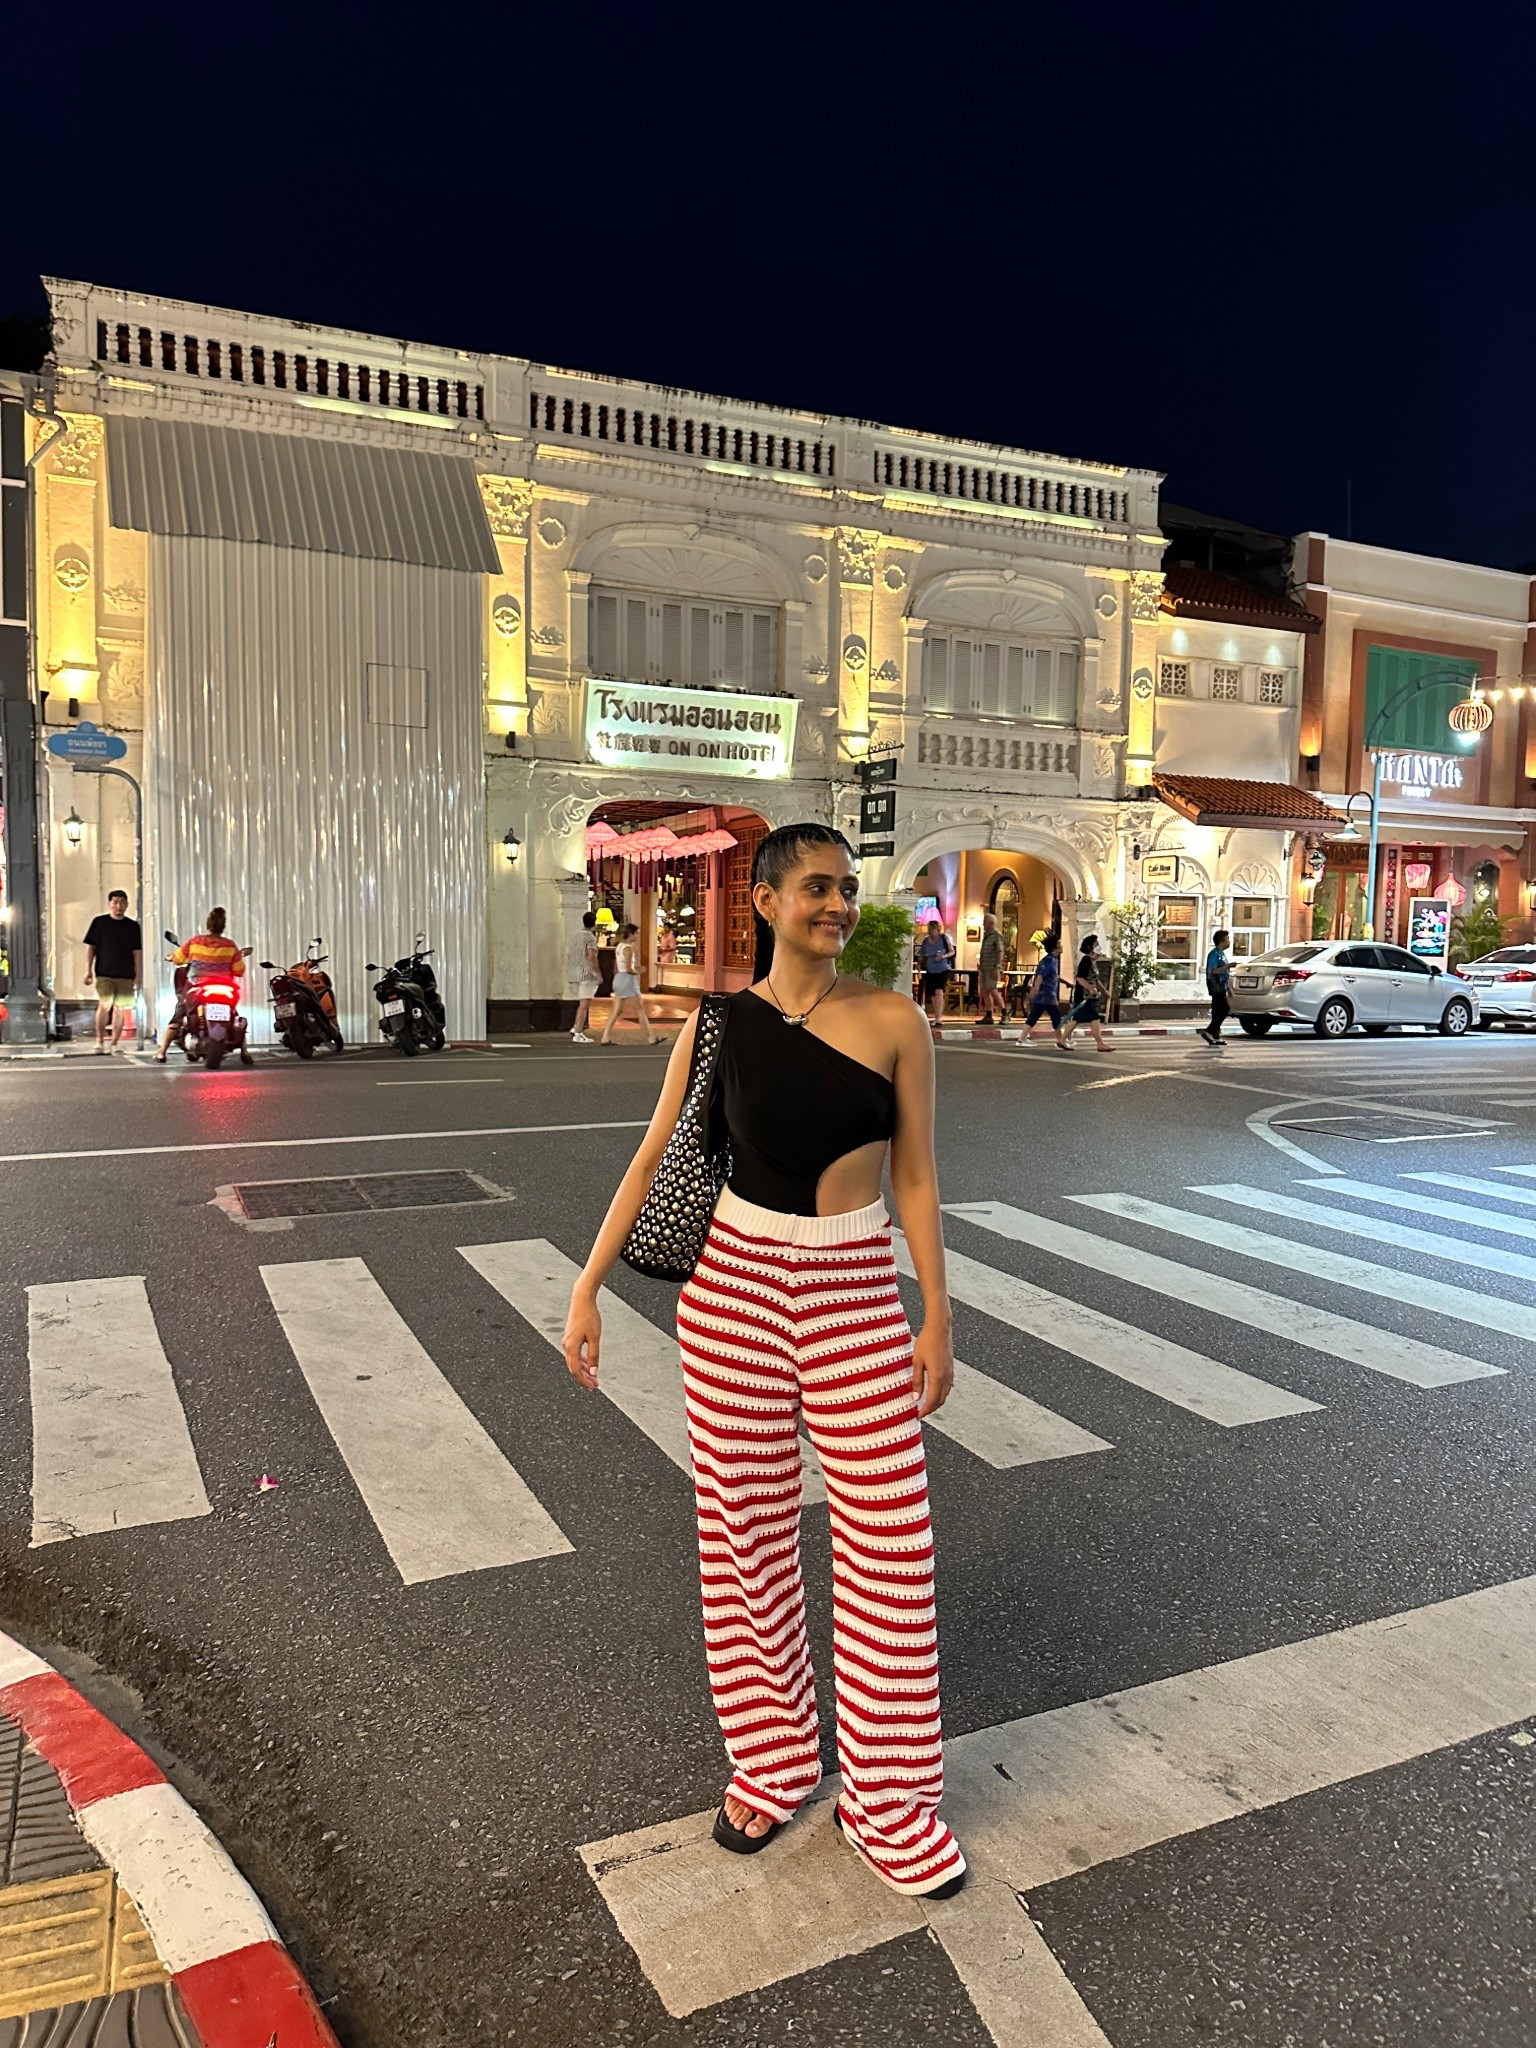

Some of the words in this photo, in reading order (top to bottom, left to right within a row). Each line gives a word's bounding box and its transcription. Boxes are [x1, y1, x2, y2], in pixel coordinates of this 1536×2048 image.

[594, 689, 782, 734] โรงแรมออนออน
[668, 740, 691, 756] ON
[698, 743, 720, 758] ON
